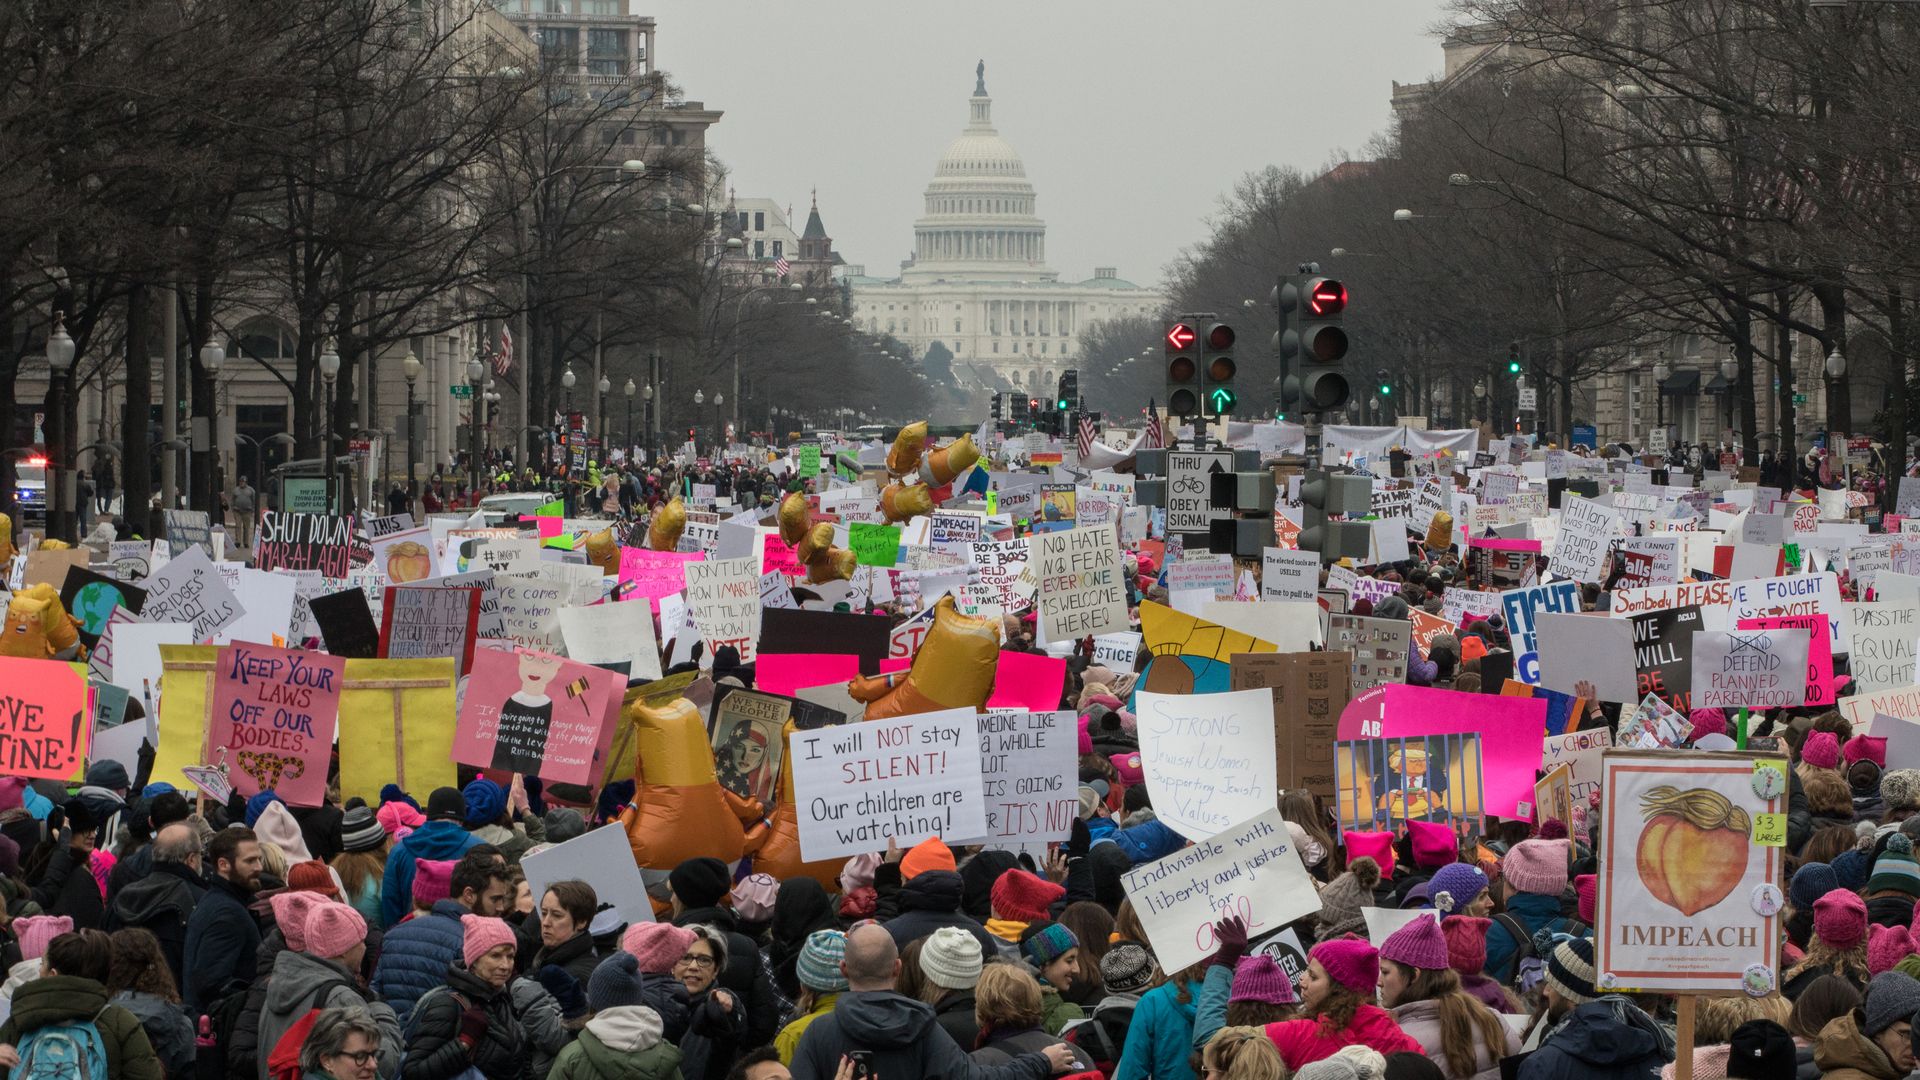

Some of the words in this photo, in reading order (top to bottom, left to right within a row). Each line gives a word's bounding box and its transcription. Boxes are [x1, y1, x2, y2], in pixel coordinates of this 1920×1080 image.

[1172, 457, 1202, 470] THRU
[840, 502, 860, 511] HAPPY
[1169, 498, 1200, 511] OBEY
[1371, 492, 1390, 503] I'M
[1507, 493, 1547, 504] DIVERSITY
[1169, 514, 1210, 527] SIGNAL
[1372, 503, 1414, 518] THEM
[1567, 498, 1611, 527] Hillary
[1796, 505, 1821, 520] STOP
[262, 511, 307, 543] SHUT
[310, 515, 352, 548] DOWN
[368, 516, 401, 531] THIS
[933, 517, 975, 532] IMPEACH
[1563, 517, 1584, 530] was
[1586, 521, 1608, 539] right
[973, 542, 1001, 553] BOYS
[1005, 539, 1030, 550] WILL
[1070, 529, 1112, 551] HATE
[1561, 527, 1599, 554] Trump
[1627, 541, 1641, 549] WE
[1645, 541, 1676, 550] CANNOT
[975, 554, 991, 565] BE
[1072, 548, 1115, 572] FEAR
[1266, 555, 1276, 564] The
[1276, 557, 1295, 566] elected
[1295, 558, 1307, 567] tools
[1855, 551, 1872, 561] END
[1873, 549, 1889, 560] THE
[489, 562, 510, 571] MY
[688, 562, 730, 585] DON'T
[732, 560, 759, 576] LIKE
[1279, 568, 1301, 577] USELESS
[1548, 556, 1590, 581] Puppet
[369, 575, 386, 587] THE
[968, 586, 990, 596] POOP
[1043, 569, 1113, 594] EVERYONE
[1354, 579, 1373, 592] I'M
[1375, 581, 1403, 593] WITH
[1766, 577, 1824, 600] FOUGHT
[148, 575, 204, 622] BRIDGES
[397, 589, 423, 606] 100%
[427, 589, 438, 606] OF
[444, 589, 471, 611] MEN
[523, 587, 558, 601] comes
[689, 584, 712, 600] HOW
[1060, 586, 1121, 612] WELCOME
[1266, 587, 1283, 598] Time
[1283, 589, 1290, 598] to
[1290, 590, 1303, 600] pull
[1303, 591, 1314, 600] the
[1455, 590, 1485, 603] FEMINIST
[1485, 594, 1494, 606] IS
[1614, 589, 1672, 614] Sombody
[171, 594, 205, 623] NOT
[394, 607, 438, 626] TRYING
[446, 608, 458, 625] TO
[524, 604, 551, 617] when
[694, 605, 716, 619] WAIT
[740, 603, 757, 616] YOU
[964, 606, 979, 615] BUT
[1503, 584, 1577, 635] FIGHT
[1677, 611, 1697, 623] ACLU
[1783, 600, 1820, 617] VOTE
[1853, 607, 1891, 627] PASS
[1892, 608, 1917, 625] THE
[193, 601, 234, 640] WALLS
[529, 619, 539, 630] is
[715, 622, 743, 637] HOW
[1056, 607, 1110, 635] HERE!
[1632, 618, 1660, 643] WE
[446, 625, 466, 643] MY
[391, 641, 426, 656] UTERUS
[426, 642, 454, 657] CAN'T
[1633, 642, 1684, 670] WILL
[1851, 633, 1919, 661] EQUAL
[230, 648, 284, 685] KEEP
[284, 655, 335, 693] YOUR
[1723, 653, 1781, 673] DEFEND
[1637, 670, 1666, 696] BE
[1711, 671, 1780, 690] PLANNED
[257, 682, 313, 709] LAWS
[732, 696, 753, 707] WE
[755, 702, 781, 713] THE
[1358, 688, 1384, 704] Feminist
[1703, 689, 1796, 708] PARENTHOOD
[230, 698, 266, 725] OFF
[273, 708, 315, 739] OUR
[731, 705, 779, 722] PEOPLE
[1028, 712, 1057, 730] LIKE
[1149, 700, 1242, 738] STRONG
[1845, 700, 1867, 725] I
[522, 724, 533, 734] be
[225, 722, 311, 757] BODIES.
[510, 736, 522, 746] the
[804, 738, 824, 760] I
[833, 731, 863, 755] will
[877, 724, 915, 750] NOT
[921, 727, 963, 753] stay
[981, 734, 992, 753] a
[1000, 731, 1047, 752] WHOLE
[1550, 743, 1562, 759] by
[1563, 733, 1609, 752] CHOICE
[511, 746, 531, 758] RUTH
[1197, 741, 1252, 771] Women
[842, 750, 949, 785] SILENT!
[982, 754, 1009, 774] LOT.
[985, 780, 1007, 798] IS
[1016, 774, 1064, 796] GOING
[1150, 768, 1215, 805] Supporting
[1219, 773, 1262, 801] Jewish
[811, 796, 849, 823] Our
[856, 789, 926, 817] children
[932, 788, 964, 806] are
[1173, 795, 1230, 827] Values
[836, 805, 952, 845] watching!
[997, 804, 1039, 838] IT'S
[1046, 800, 1079, 835] NOT
[1755, 832, 1783, 843] LARGE
[1122, 840, 1225, 894] Indivisible
[1234, 821, 1275, 847] with
[1144, 877, 1210, 915] liberty
[1214, 861, 1242, 886] and
[1245, 844, 1288, 882] justice
[1208, 892, 1234, 913] for
[1620, 924, 1759, 948] IMPEACH
